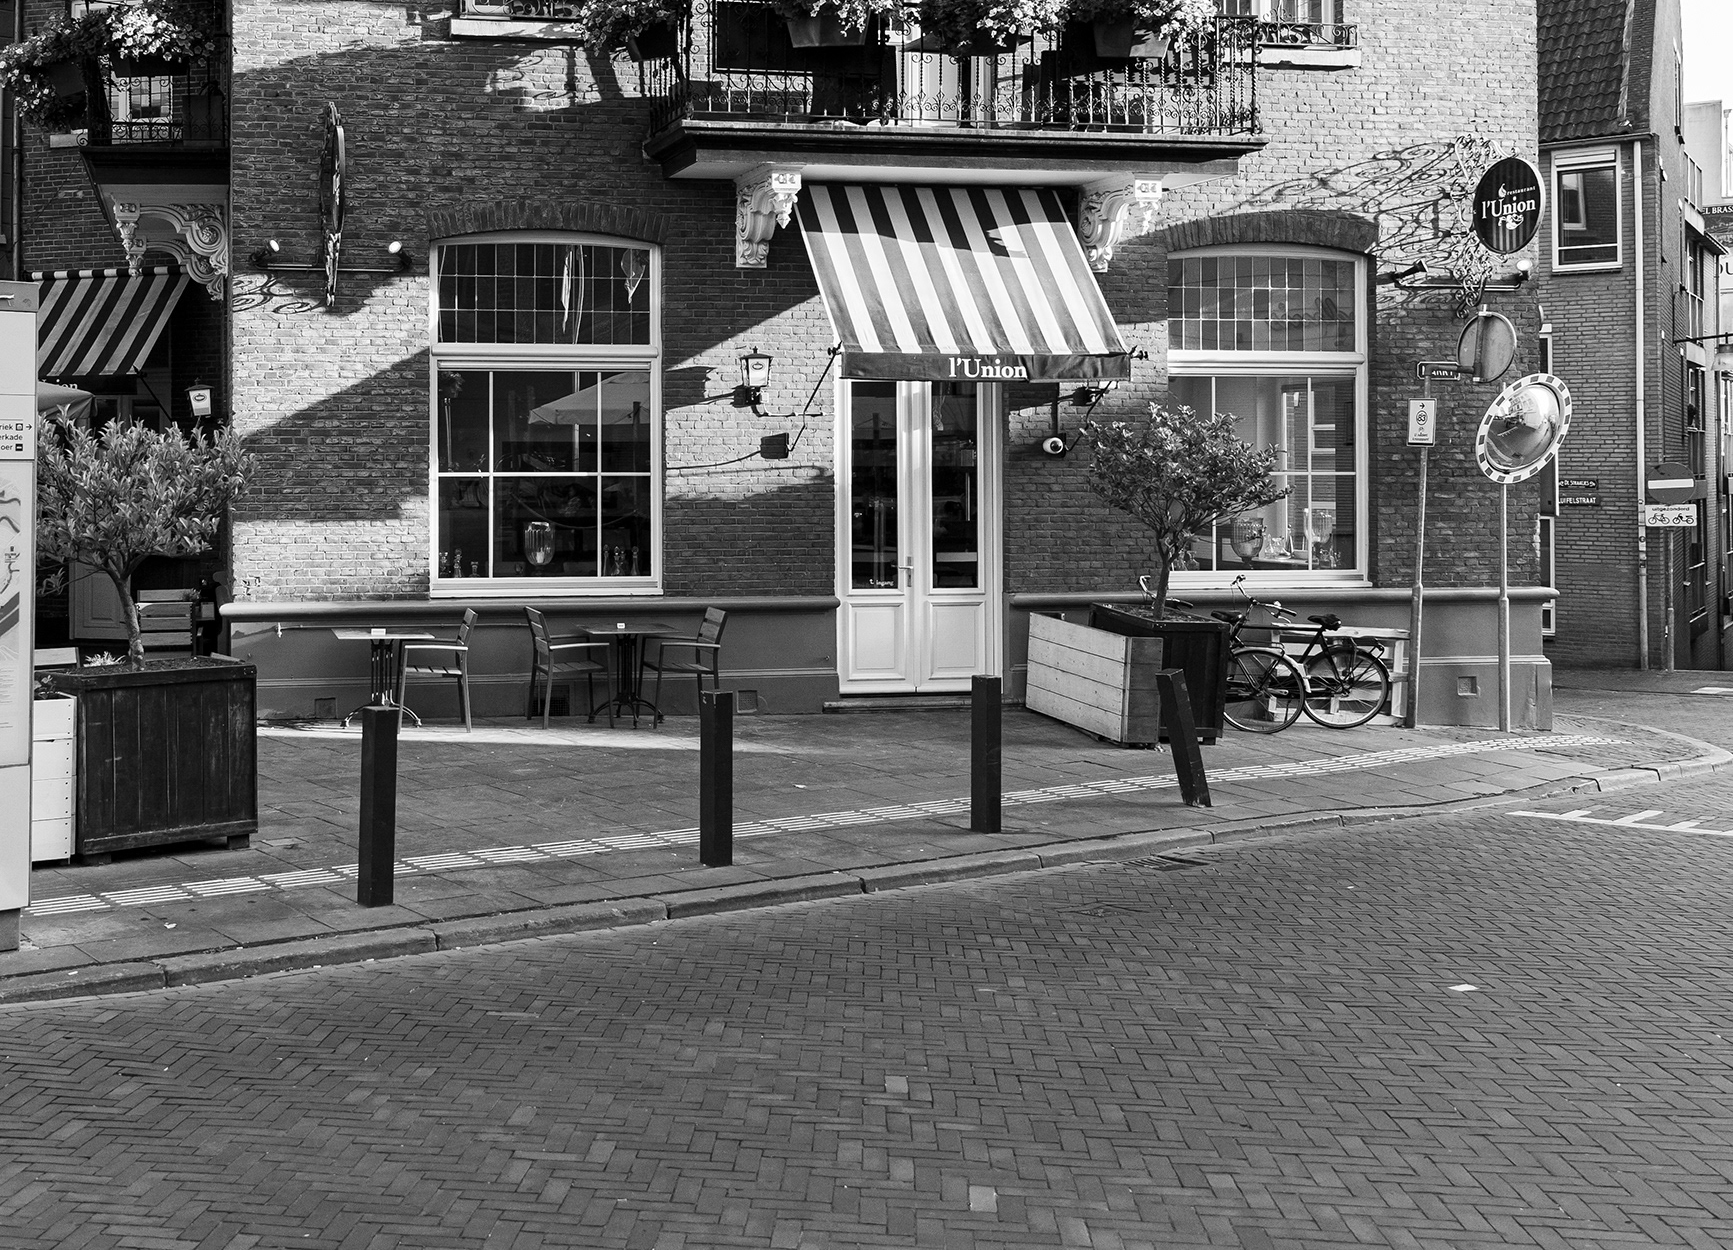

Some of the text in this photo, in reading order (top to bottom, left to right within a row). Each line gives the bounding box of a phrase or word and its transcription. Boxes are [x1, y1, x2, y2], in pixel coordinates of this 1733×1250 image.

[1506, 185, 1536, 196] restaurant
[1481, 196, 1536, 220] l'Union
[1711, 205, 1733, 214] BRAS
[948, 357, 1028, 379] l'Union
